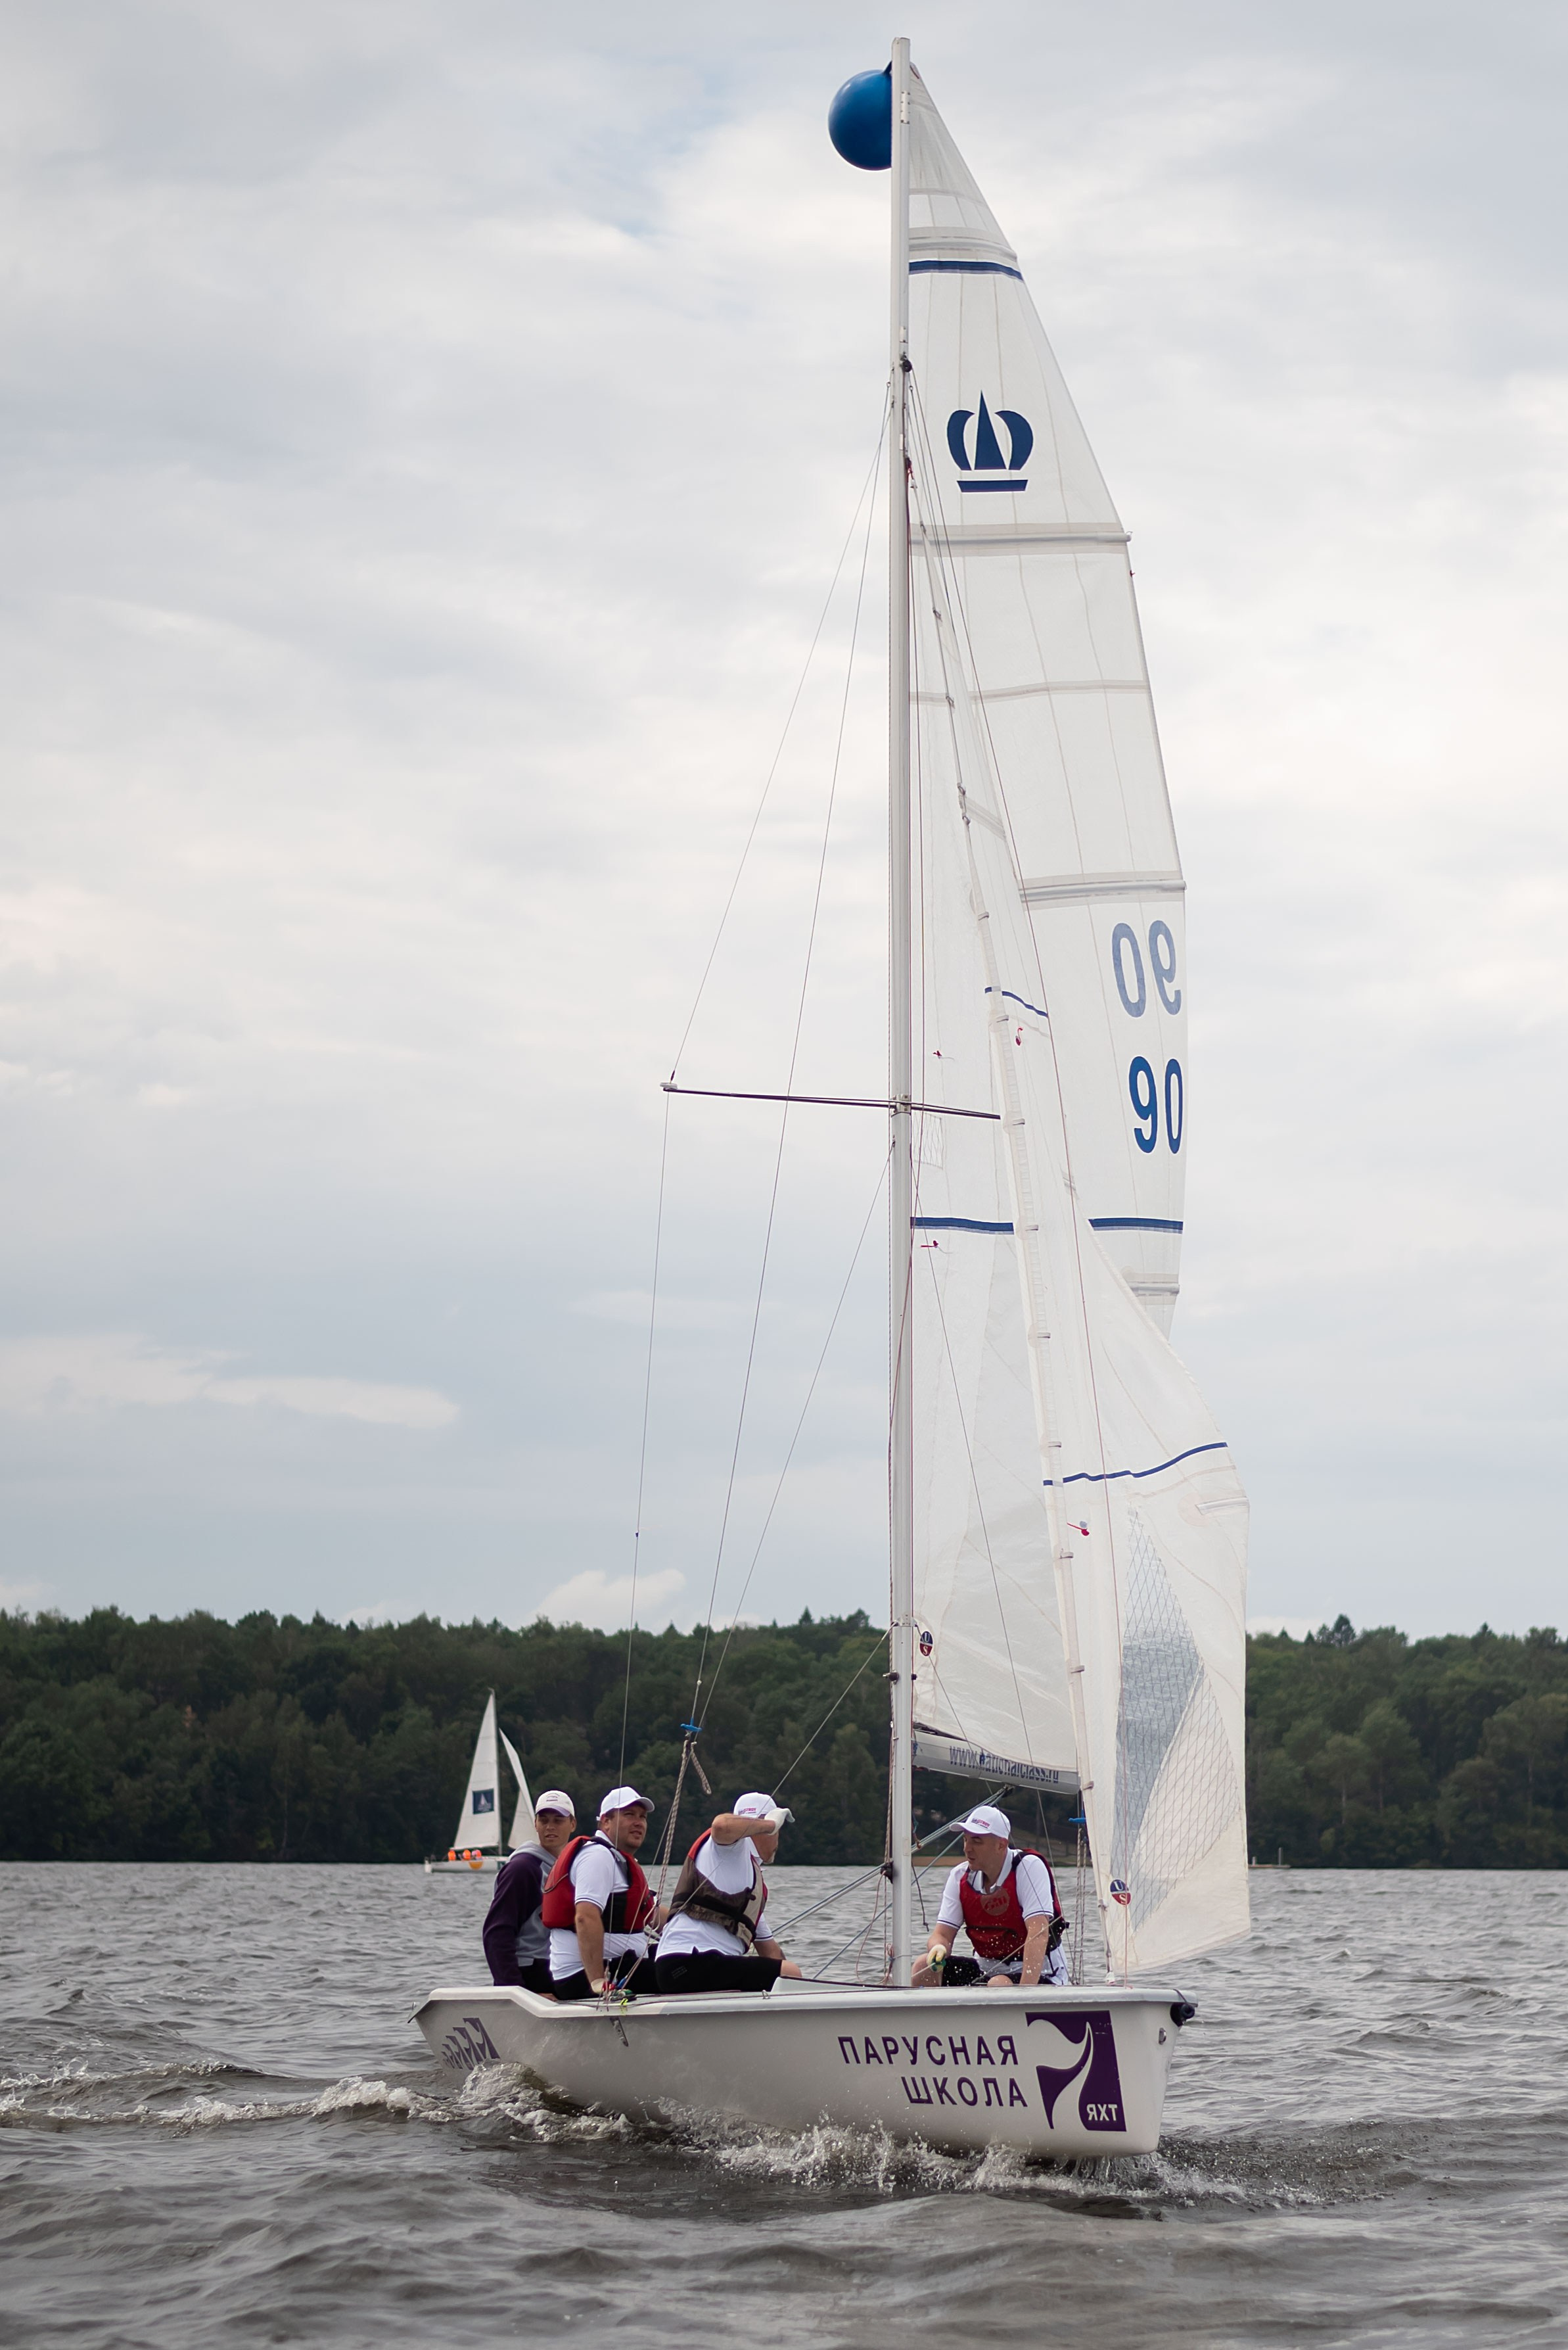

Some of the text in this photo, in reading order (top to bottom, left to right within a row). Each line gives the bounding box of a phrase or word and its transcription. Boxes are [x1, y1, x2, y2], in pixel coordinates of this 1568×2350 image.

[1129, 1056, 1183, 1154] 90
[838, 2035, 1019, 2065] ПАРУСНАЯ
[901, 2076, 1028, 2107] ШКОЛА
[1086, 2103, 1118, 2121] ЯХТ
